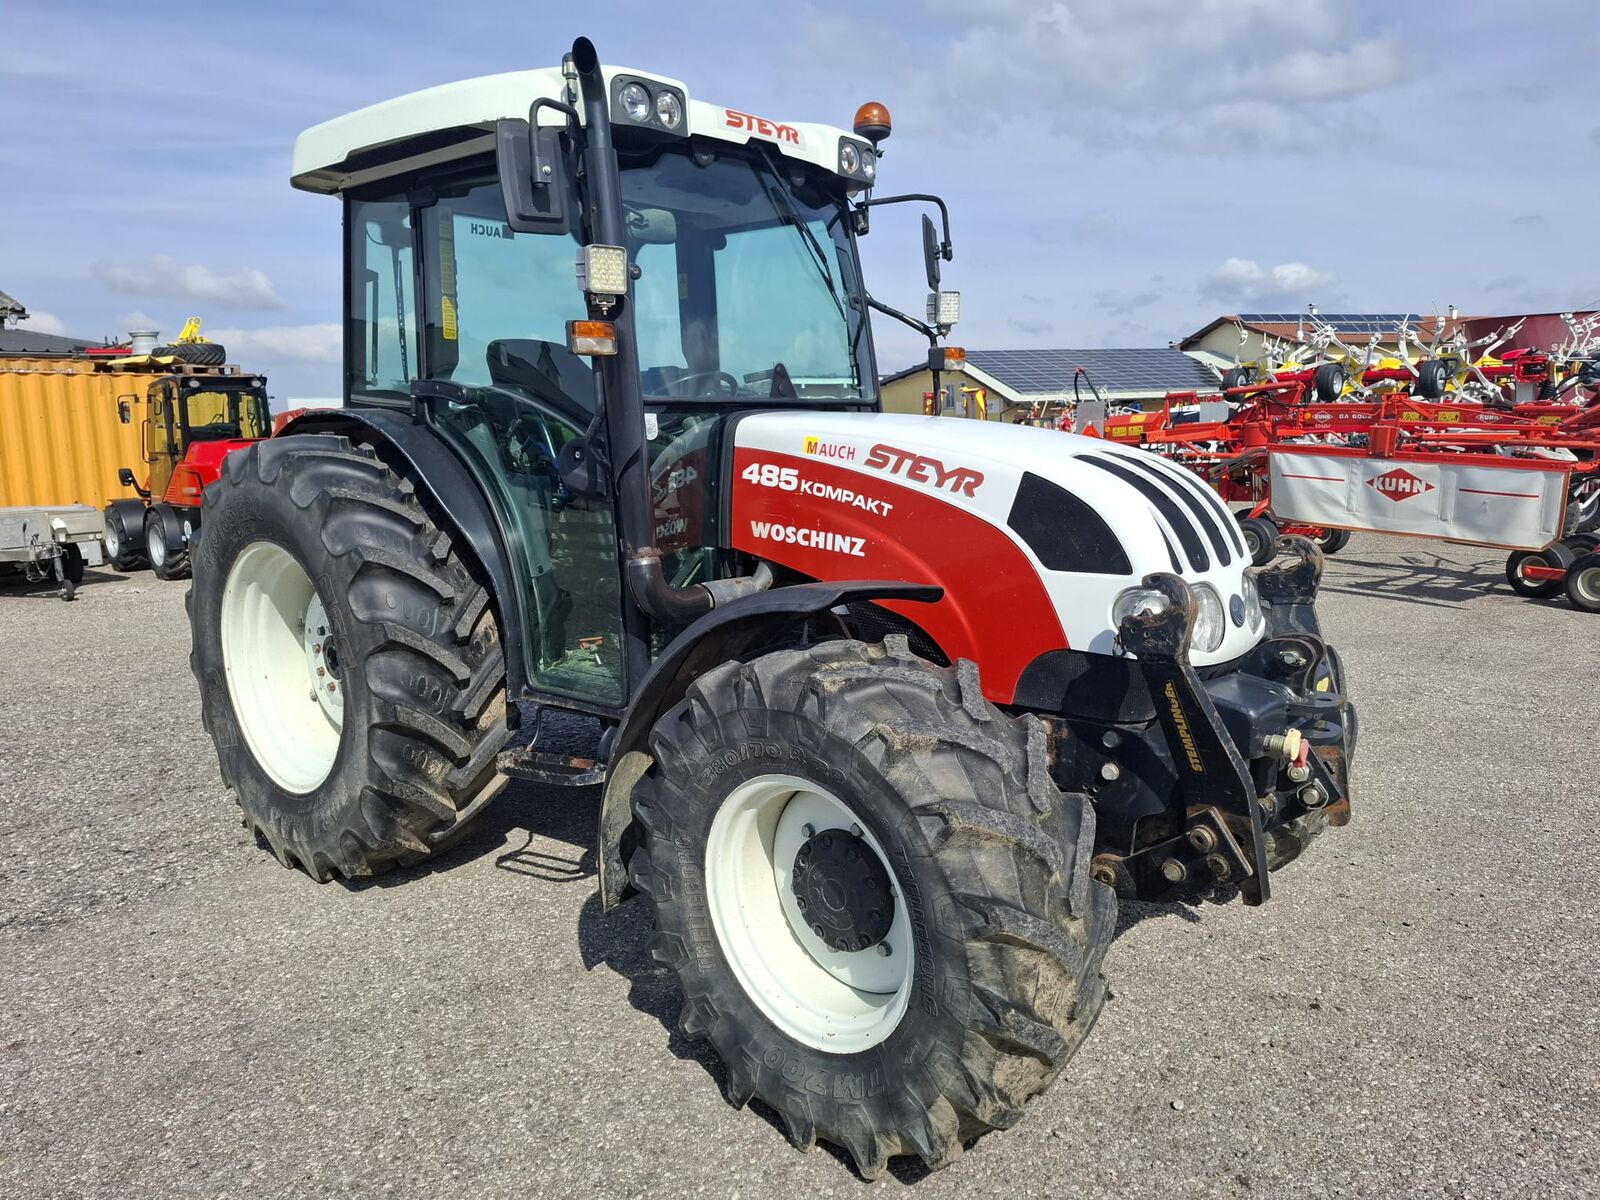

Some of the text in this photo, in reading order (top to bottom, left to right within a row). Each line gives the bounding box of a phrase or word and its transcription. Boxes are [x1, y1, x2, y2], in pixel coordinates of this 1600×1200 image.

[725, 109, 799, 145] STEYR
[806, 439, 856, 461] MAUCH
[864, 443, 985, 498] STEYR
[742, 463, 893, 517] 485 KOMPAKT
[1373, 476, 1426, 494] KUHN
[751, 520, 866, 557] WOSCHINZ
[1165, 681, 1204, 773] STEMPLINGER
[899, 844, 939, 1018] TRELLEBORG
[763, 1046, 828, 1097] 700
